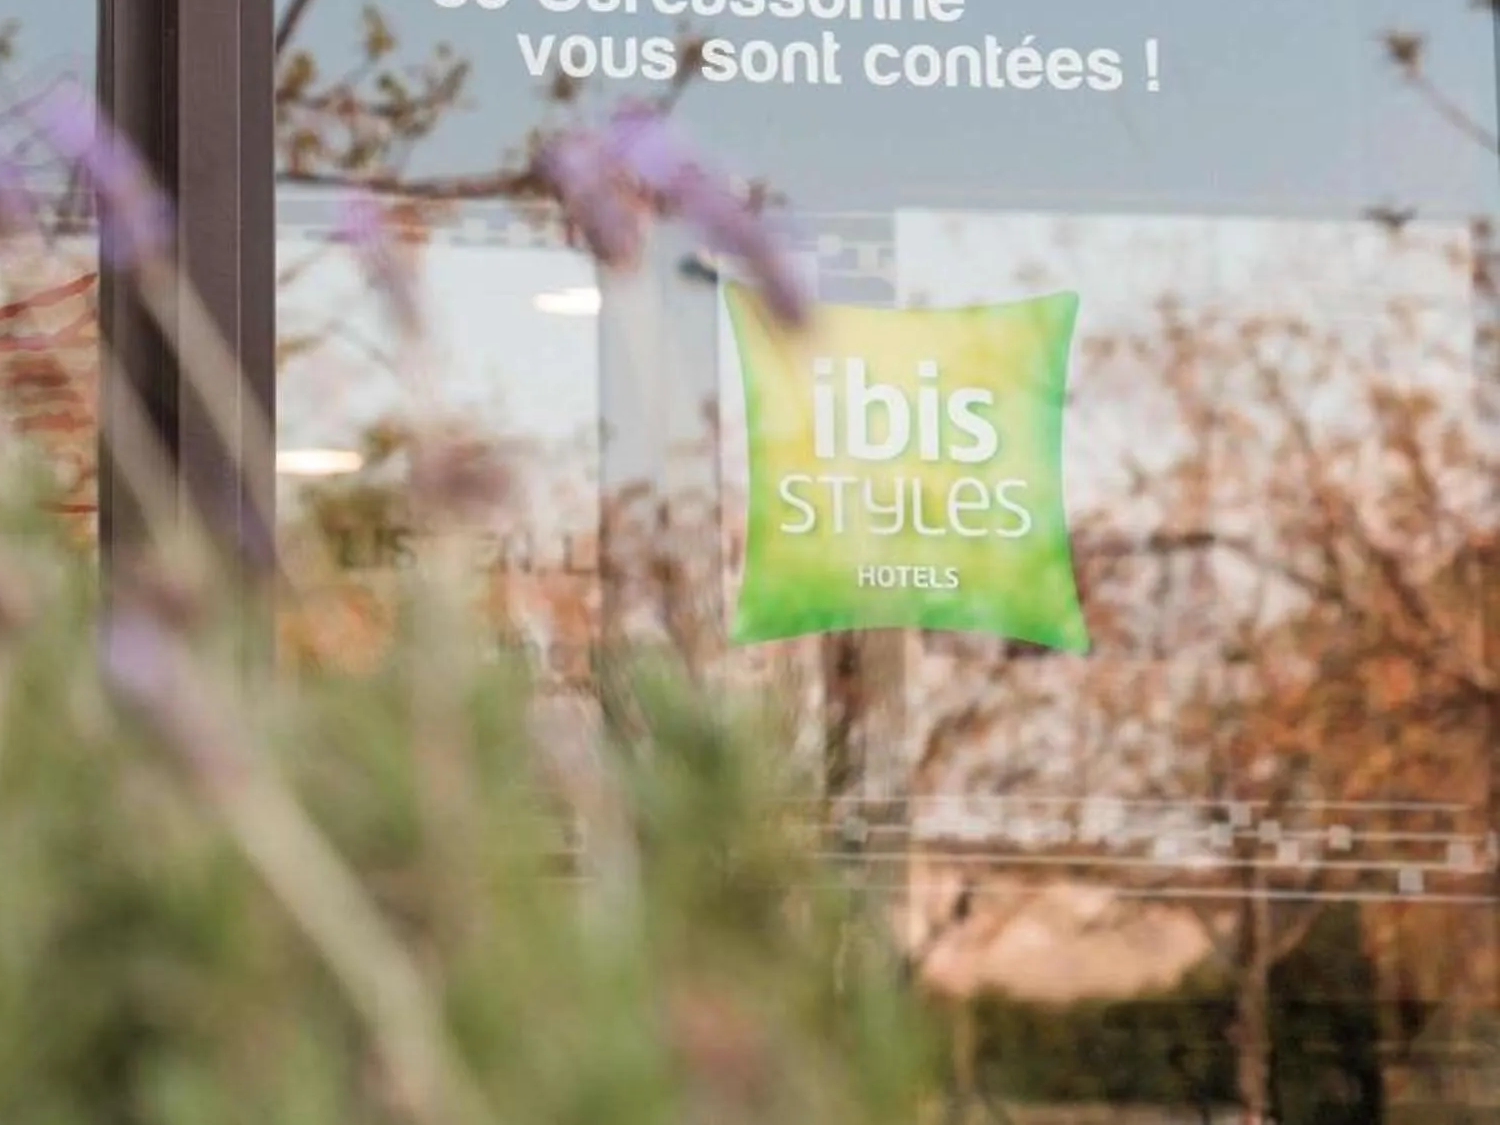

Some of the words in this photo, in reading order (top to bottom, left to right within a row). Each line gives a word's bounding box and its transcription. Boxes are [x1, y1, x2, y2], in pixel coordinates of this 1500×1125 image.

[516, 32, 678, 81] vous
[700, 29, 843, 85] sont
[862, 34, 1124, 93] contées
[1143, 37, 1161, 93] !
[812, 356, 999, 464] ibis
[857, 565, 960, 589] HOTELS
